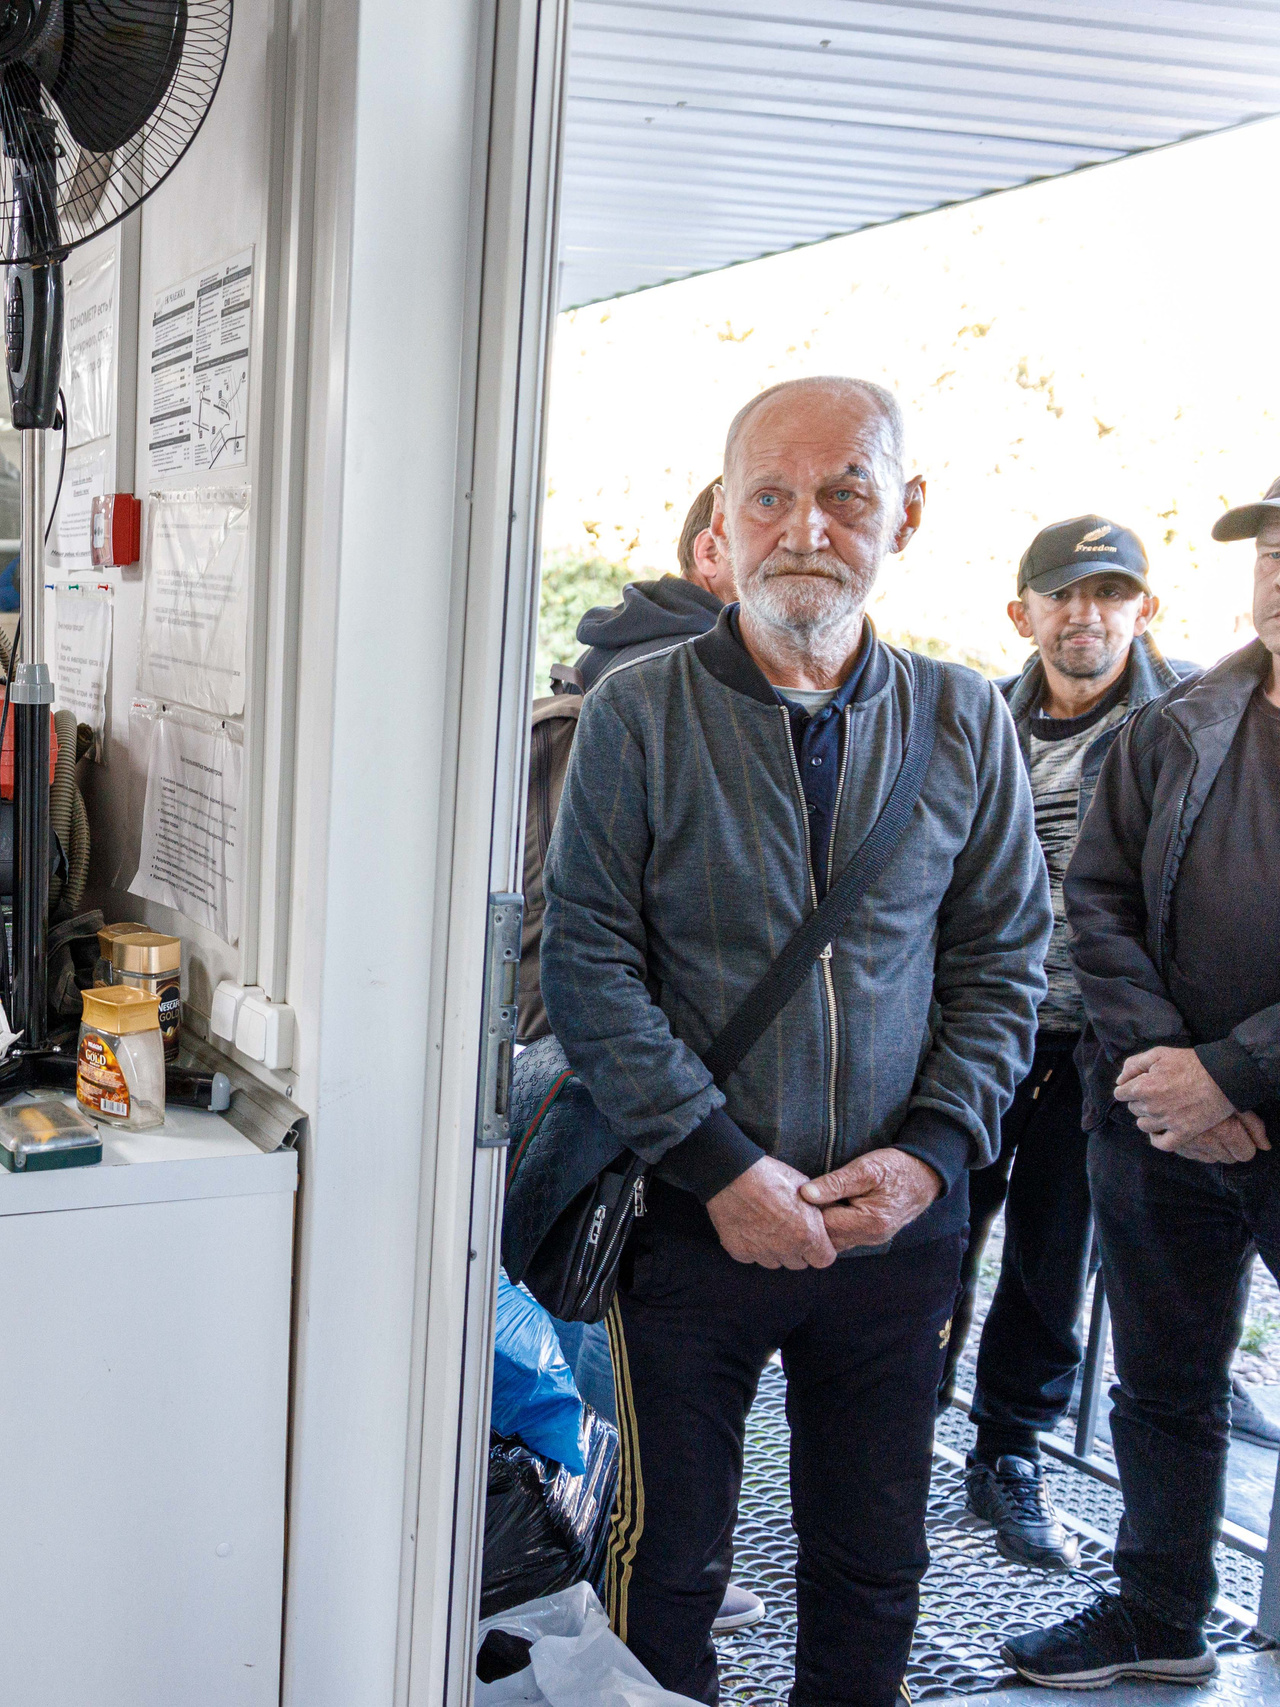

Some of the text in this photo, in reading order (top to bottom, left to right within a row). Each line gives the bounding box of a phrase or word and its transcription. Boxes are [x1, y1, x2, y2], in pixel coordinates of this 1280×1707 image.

[1074, 544, 1118, 553] Freedom
[159, 1008, 180, 1022] GOLD
[85, 1049, 107, 1066] GOLD
